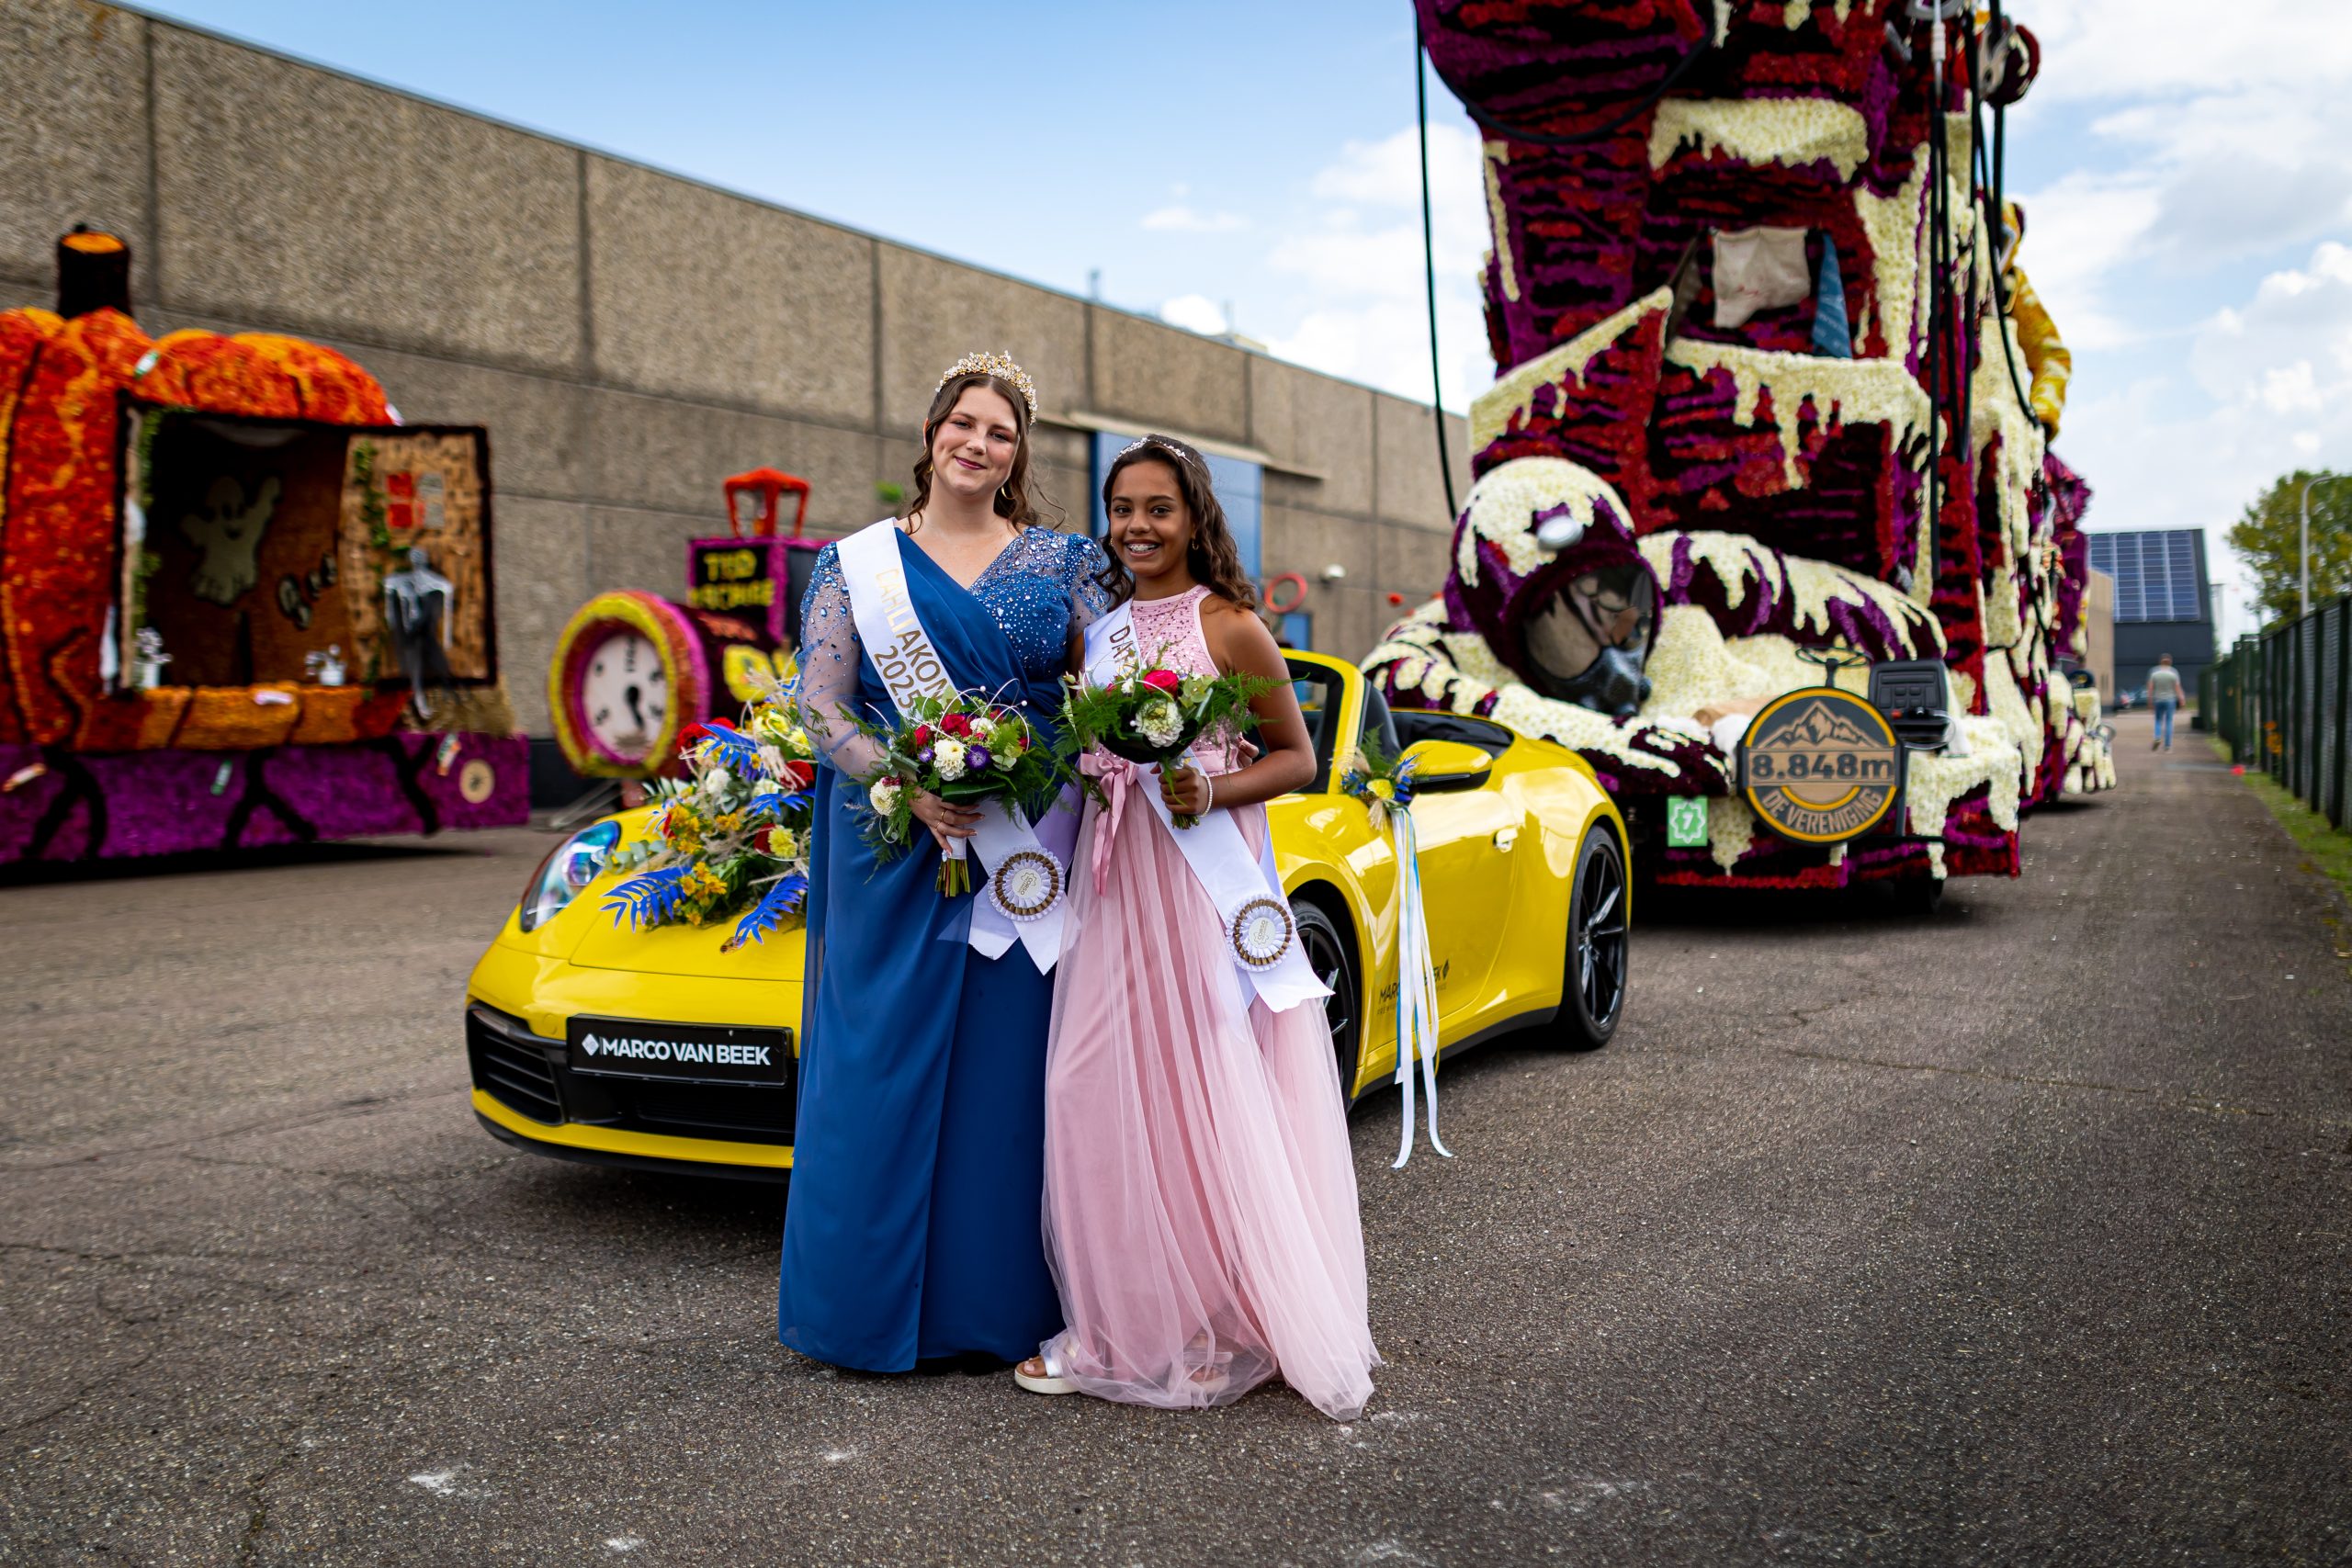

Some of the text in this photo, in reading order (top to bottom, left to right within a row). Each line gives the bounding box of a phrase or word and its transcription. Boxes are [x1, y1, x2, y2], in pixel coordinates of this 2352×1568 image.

[875, 645, 922, 709] 2025
[1752, 753, 1893, 779] 8.848m
[1682, 812, 1693, 830] 7
[1762, 788, 1883, 835] DE VERENIGING
[602, 1038, 771, 1066] MARCO VAN BEEK
